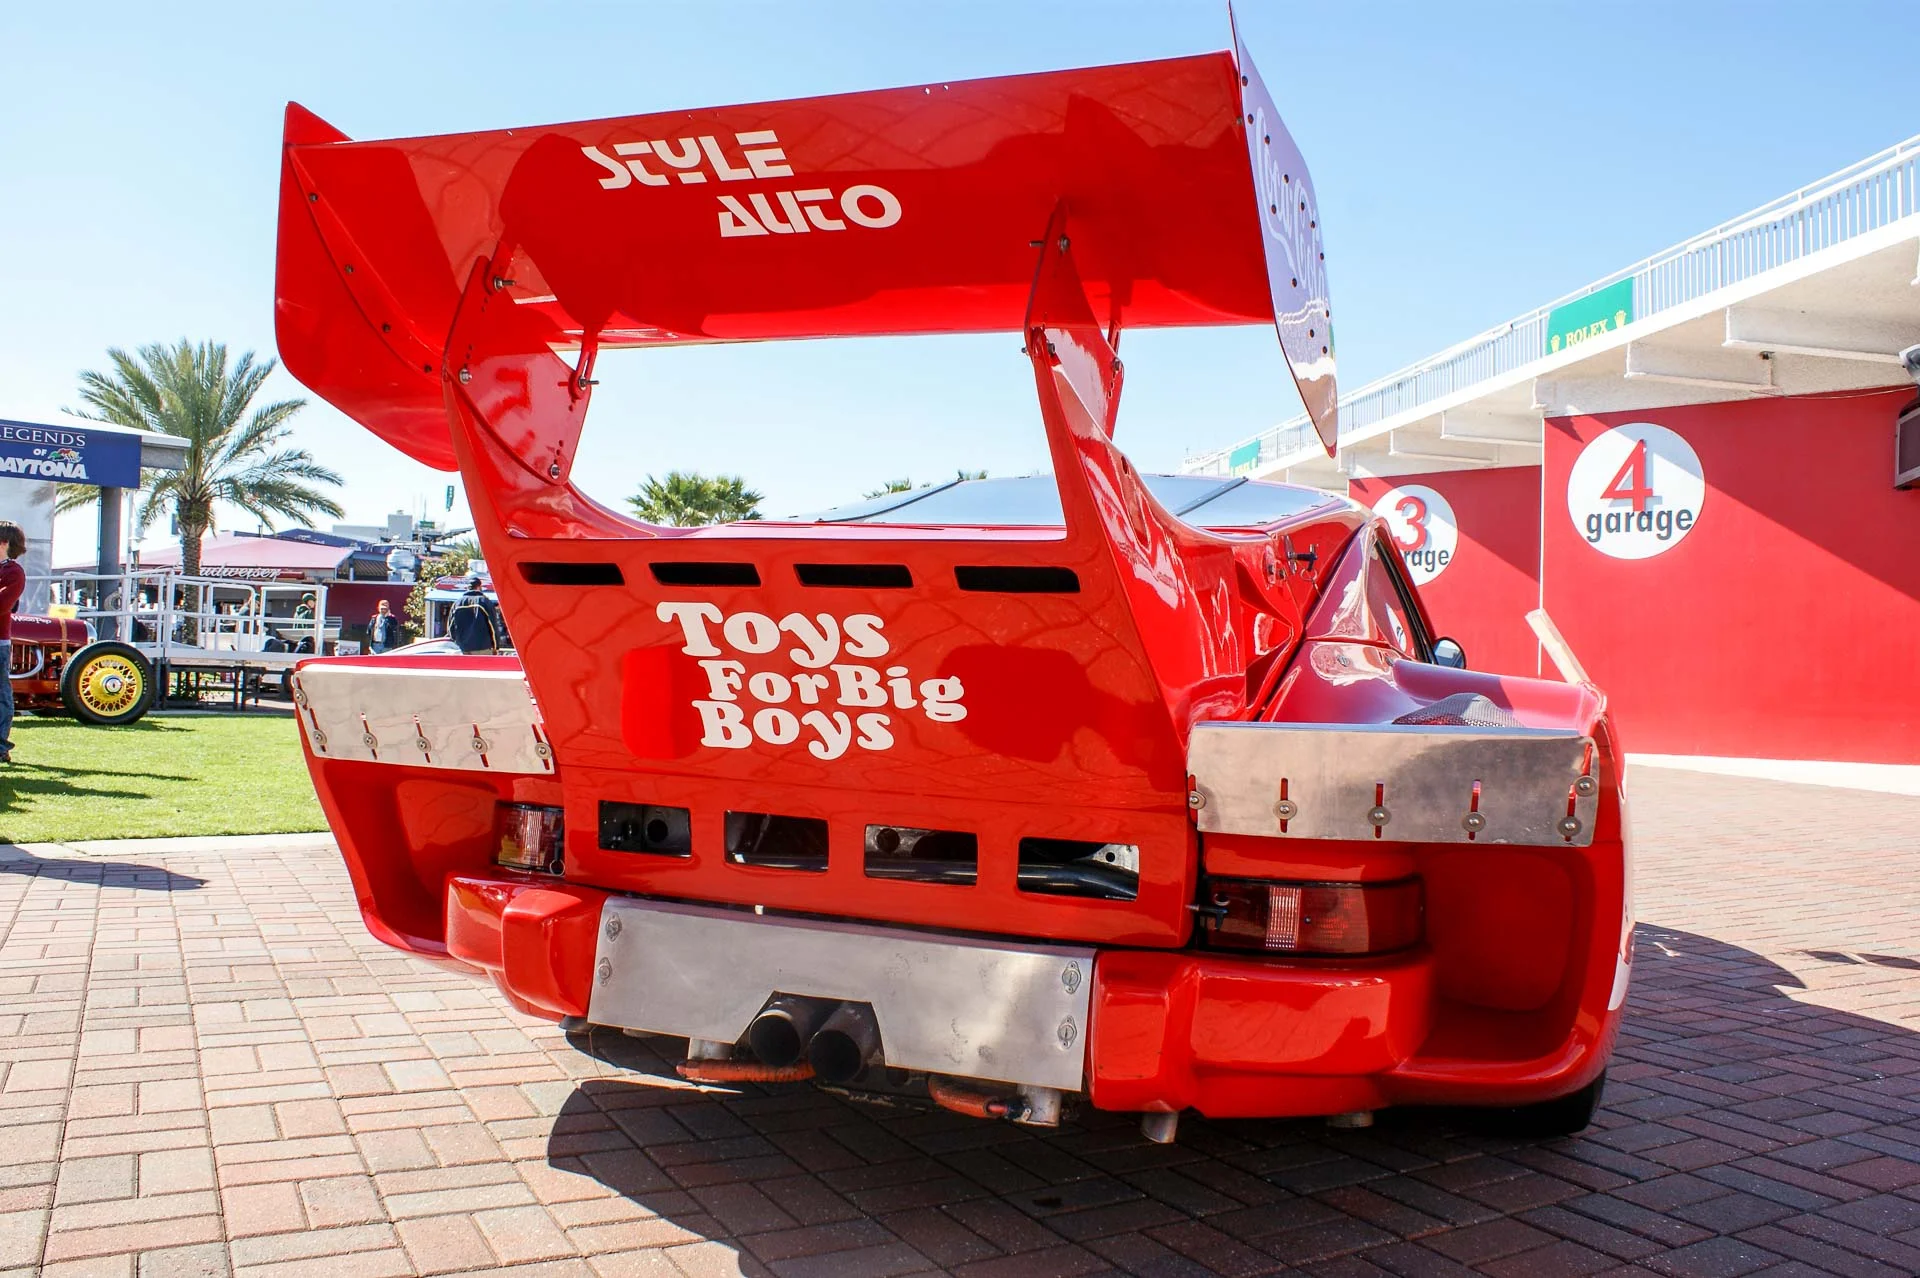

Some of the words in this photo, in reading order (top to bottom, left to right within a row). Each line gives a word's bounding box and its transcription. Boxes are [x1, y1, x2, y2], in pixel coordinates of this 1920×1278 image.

[581, 130, 795, 190] STYLE
[717, 184, 902, 238] AUTO
[1566, 319, 1608, 348] ROLEX
[33, 448, 47, 456] OF
[1600, 439, 1653, 512] 4
[1393, 496, 1427, 551] 3
[1586, 508, 1693, 543] garage
[200, 564, 281, 583] udweiser
[1404, 550, 1449, 573] rage
[656, 601, 890, 668] Toys
[691, 700, 895, 760] Boys
